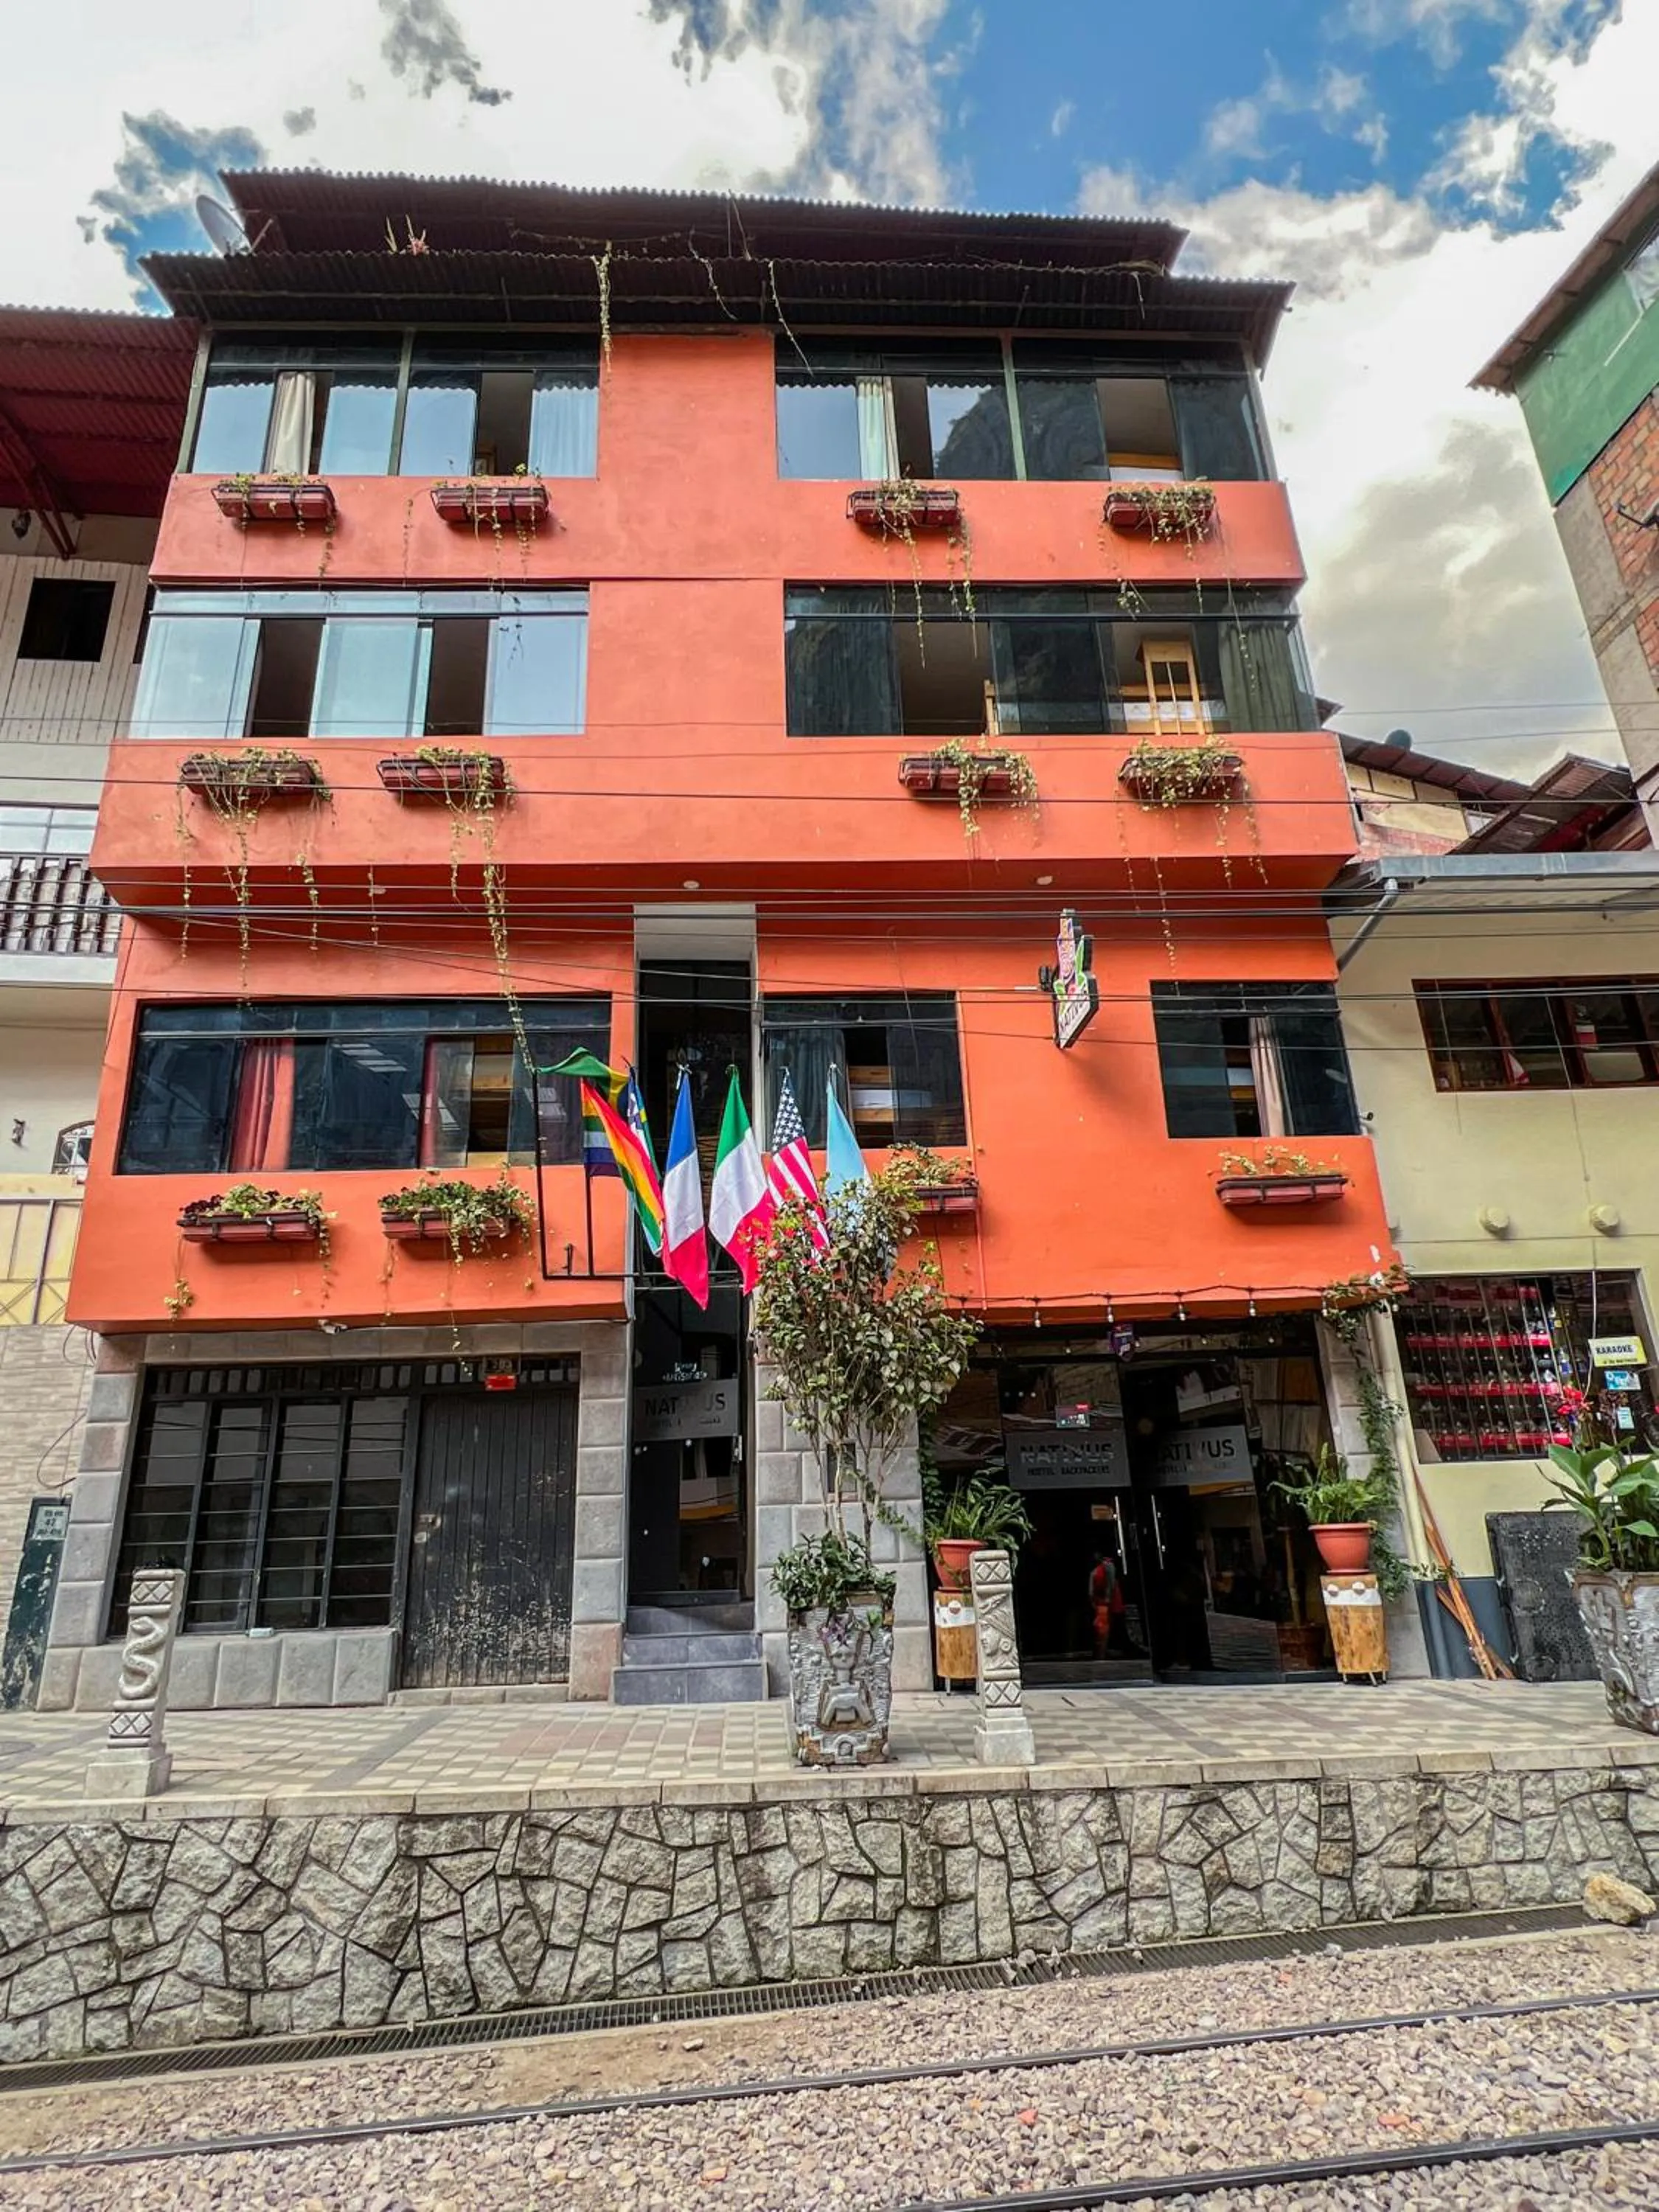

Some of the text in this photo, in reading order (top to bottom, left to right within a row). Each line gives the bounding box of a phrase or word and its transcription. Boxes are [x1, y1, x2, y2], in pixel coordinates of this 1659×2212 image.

[1595, 1345, 1633, 1354] KARAOKE
[644, 1392, 726, 1416] NATUS
[1155, 1438, 1237, 1461] ATIUS
